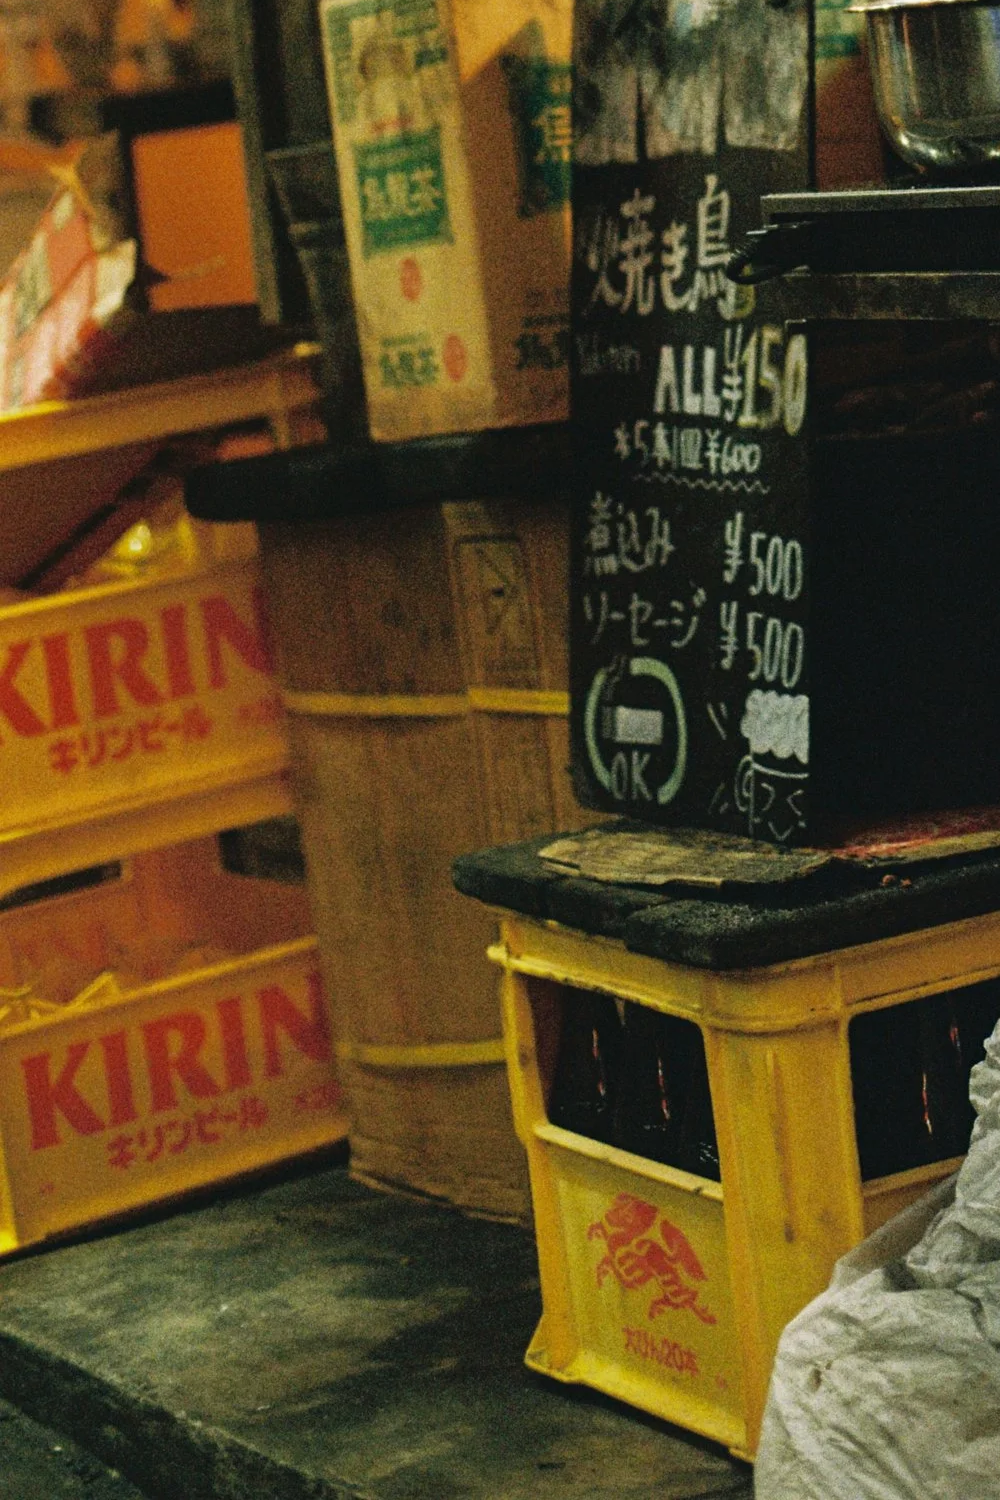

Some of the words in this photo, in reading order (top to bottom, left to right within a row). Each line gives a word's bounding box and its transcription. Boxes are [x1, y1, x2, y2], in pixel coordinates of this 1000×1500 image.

[653, 345, 721, 416] ALL
[722, 323, 807, 437] ¥150
[722, 511, 802, 601] ¥500
[718, 600, 804, 689] ¥500
[610, 751, 652, 800] OK
[21, 969, 334, 1151] KIRIN
